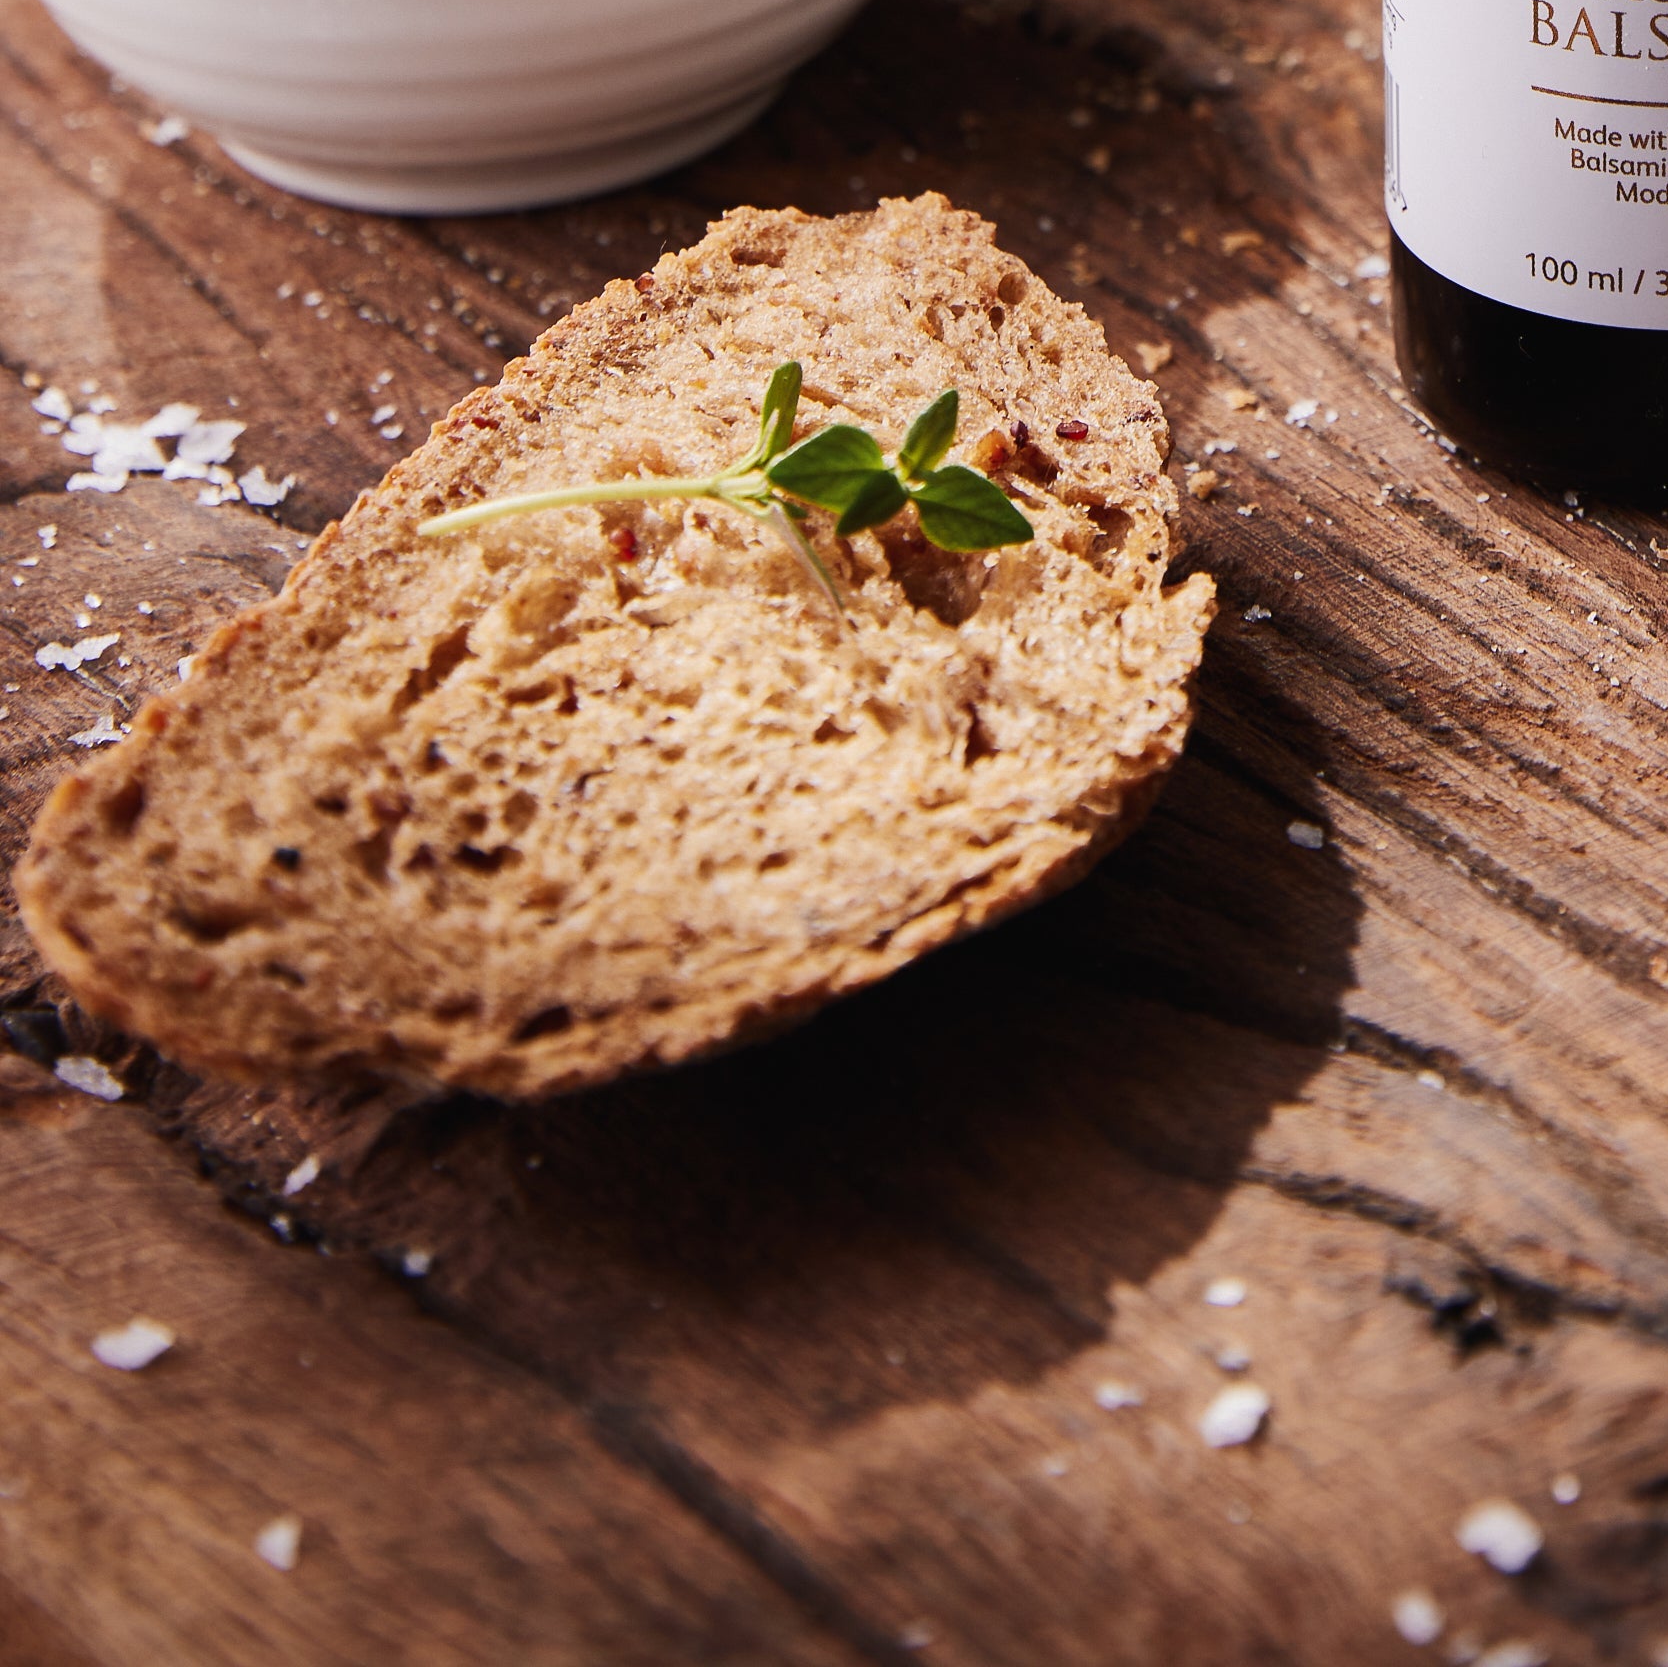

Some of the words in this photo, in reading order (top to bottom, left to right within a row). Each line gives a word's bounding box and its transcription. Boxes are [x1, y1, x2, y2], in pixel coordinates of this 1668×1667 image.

[1554, 117, 1623, 147] Made
[1525, 252, 1578, 286] 100
[1587, 266, 1624, 293] ml
[1633, 269, 1646, 295] /
